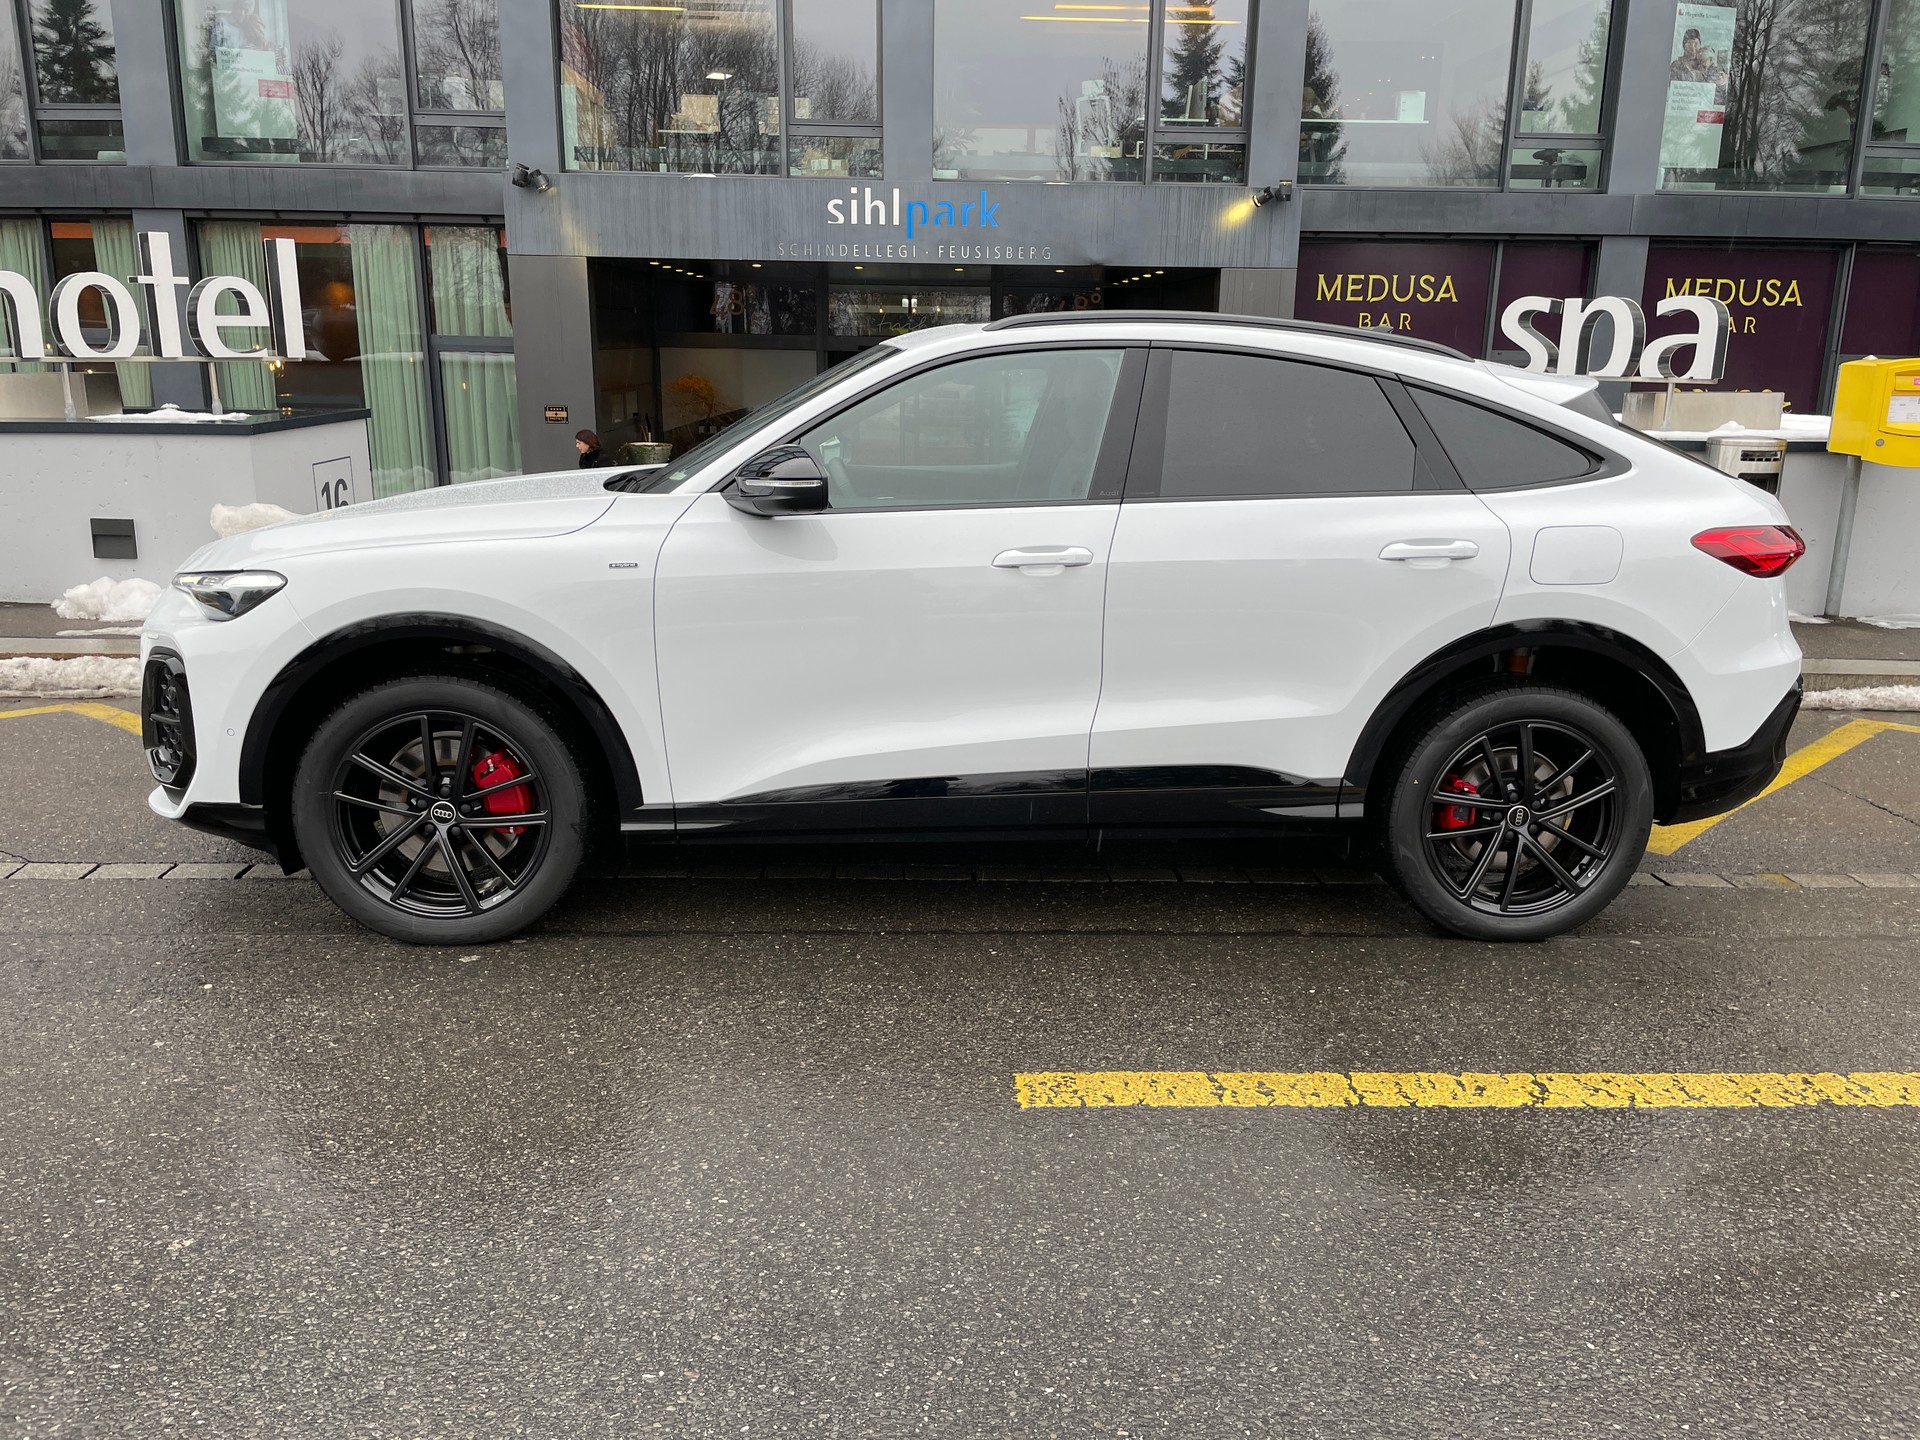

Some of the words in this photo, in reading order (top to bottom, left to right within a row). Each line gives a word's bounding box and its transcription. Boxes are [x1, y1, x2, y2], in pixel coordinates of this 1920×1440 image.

[827, 186, 1000, 240] sihlpark
[778, 242, 917, 258] SCHINDELLEGI
[937, 245, 1052, 260] FEUSISBERG
[1316, 273, 1459, 303] MEDUSA
[1665, 277, 1804, 307] MEDUSA
[1358, 312, 1412, 331] BAR
[1501, 295, 1730, 381] spa
[321, 478, 349, 510] 16
